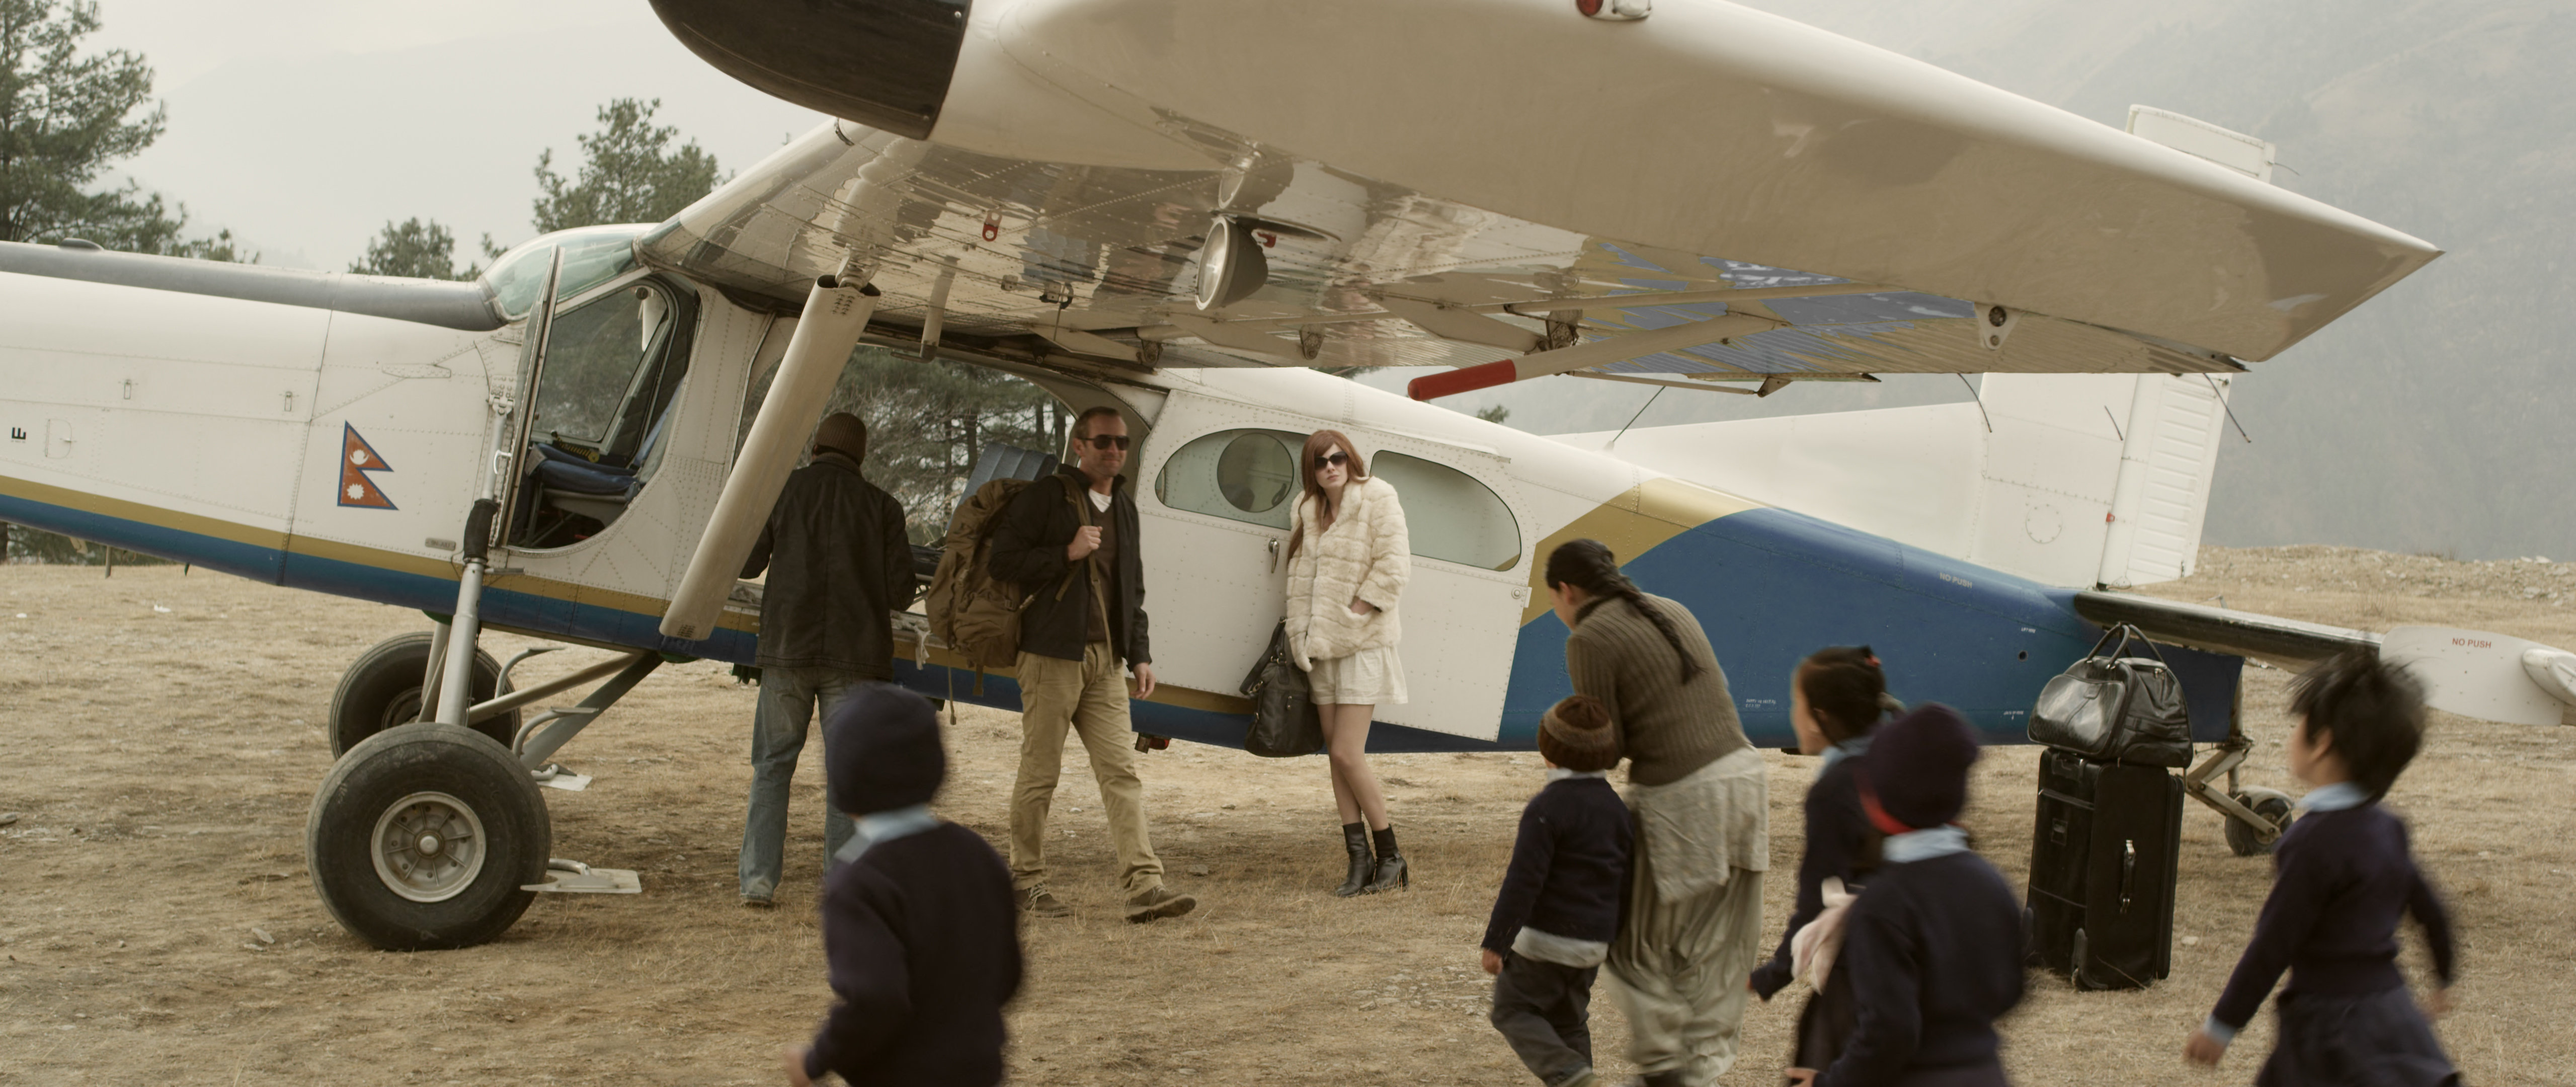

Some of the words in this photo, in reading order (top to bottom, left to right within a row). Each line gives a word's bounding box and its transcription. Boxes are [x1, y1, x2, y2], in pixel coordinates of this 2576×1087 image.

[1940, 572, 1951, 582] NO
[1952, 576, 1972, 588] PUSH
[2452, 638, 2465, 646] NO
[2467, 639, 2491, 649] PUSH
